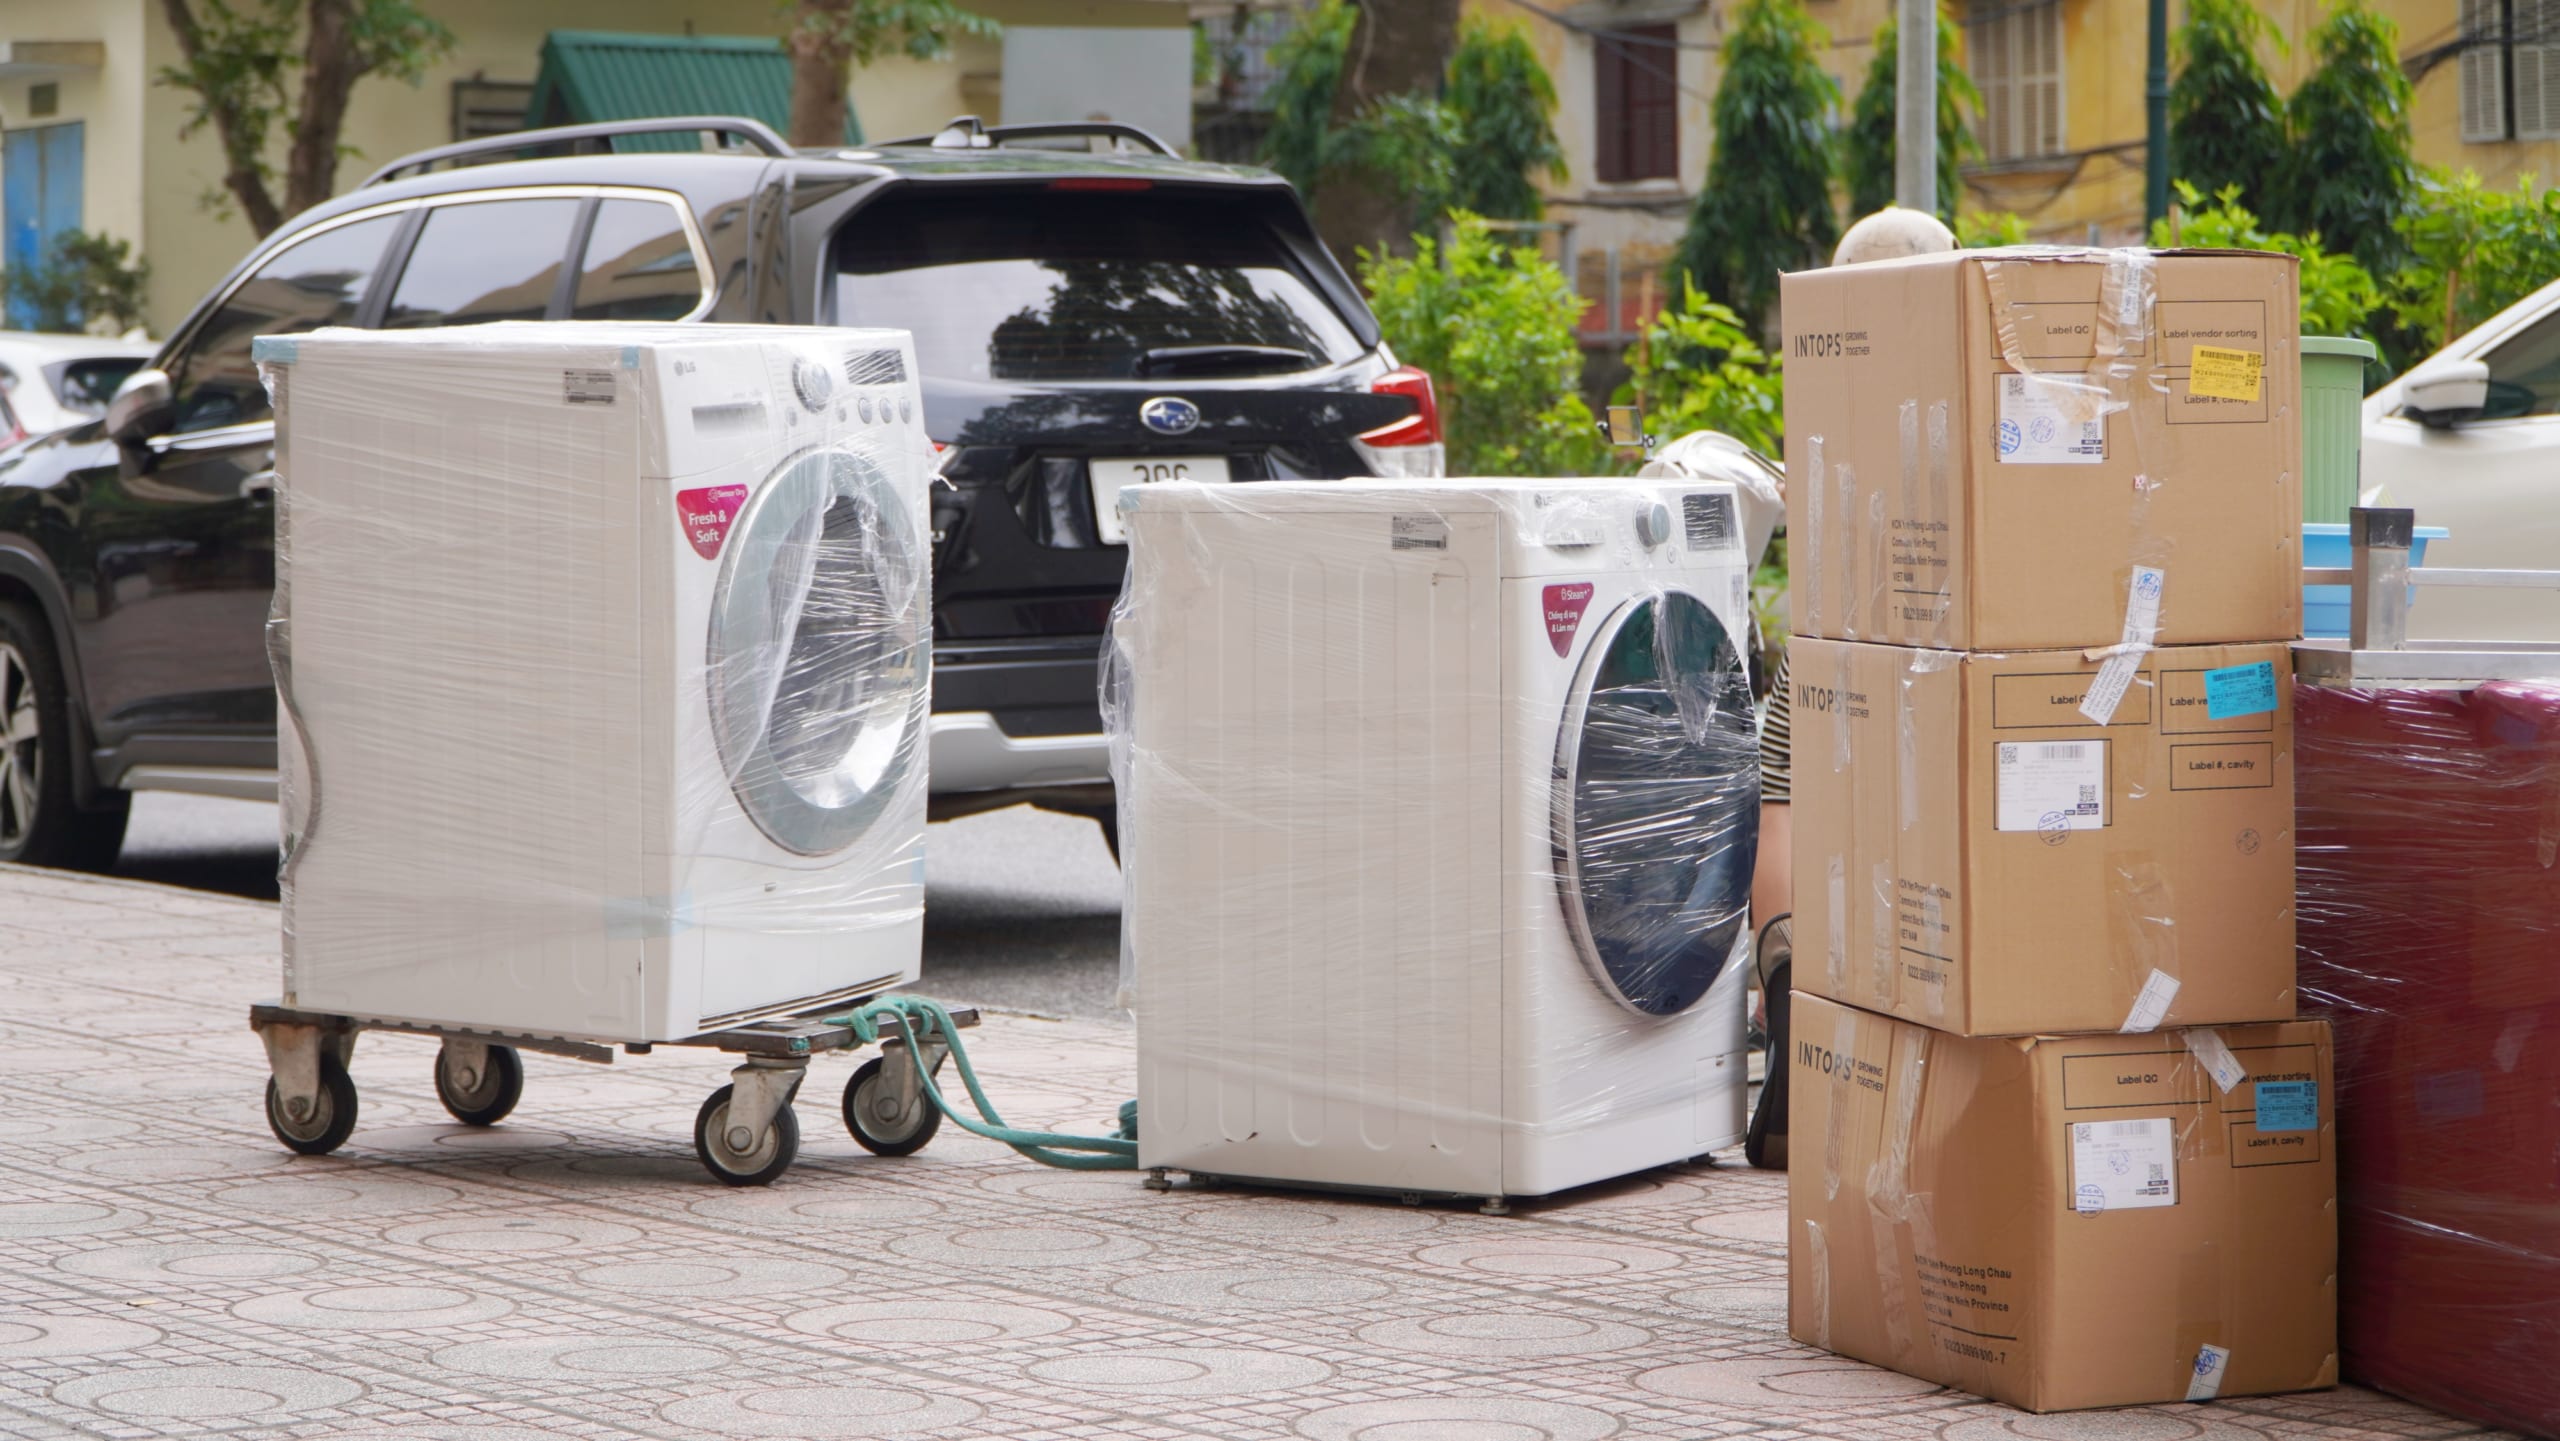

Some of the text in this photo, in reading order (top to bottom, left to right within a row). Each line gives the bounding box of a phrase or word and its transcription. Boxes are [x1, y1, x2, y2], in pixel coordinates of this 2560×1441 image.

[1845, 331, 1868, 341] GROWING
[2046, 325, 2089, 335] Label QC
[2163, 328, 2258, 341] Label vendor sorting
[1795, 333, 1841, 358] INTOPS
[1845, 346, 1870, 356] TOGETHER
[2184, 395, 2209, 404] Label
[688, 509, 727, 527] Fresh &
[696, 528, 720, 544] Soft
[1798, 684, 1842, 714] INTOPS
[2051, 695, 2077, 705] Label
[2170, 697, 2195, 706] Label
[2189, 760, 2214, 770] Label
[2227, 760, 2255, 771] cavity
[1798, 1040, 1852, 1081] INTOPS
[1858, 1060, 1883, 1078] GROWING
[1857, 1074, 1884, 1092] TOGETHER
[2117, 1074, 2158, 1084] Label QC
[2251, 1073, 2281, 1082] vendor
[2282, 1071, 2311, 1082] sorting
[2248, 1137, 2271, 1147] Label
[2281, 1136, 2305, 1147] cavity
[1940, 1261, 1962, 1276] Phong
[1963, 1265, 1986, 1279] Long
[1987, 1267, 2012, 1279] Chau
[1960, 1280, 1987, 1295] Phong
[1971, 1298, 2009, 1312] Province
[2000, 1351, 2006, 1365] 7
